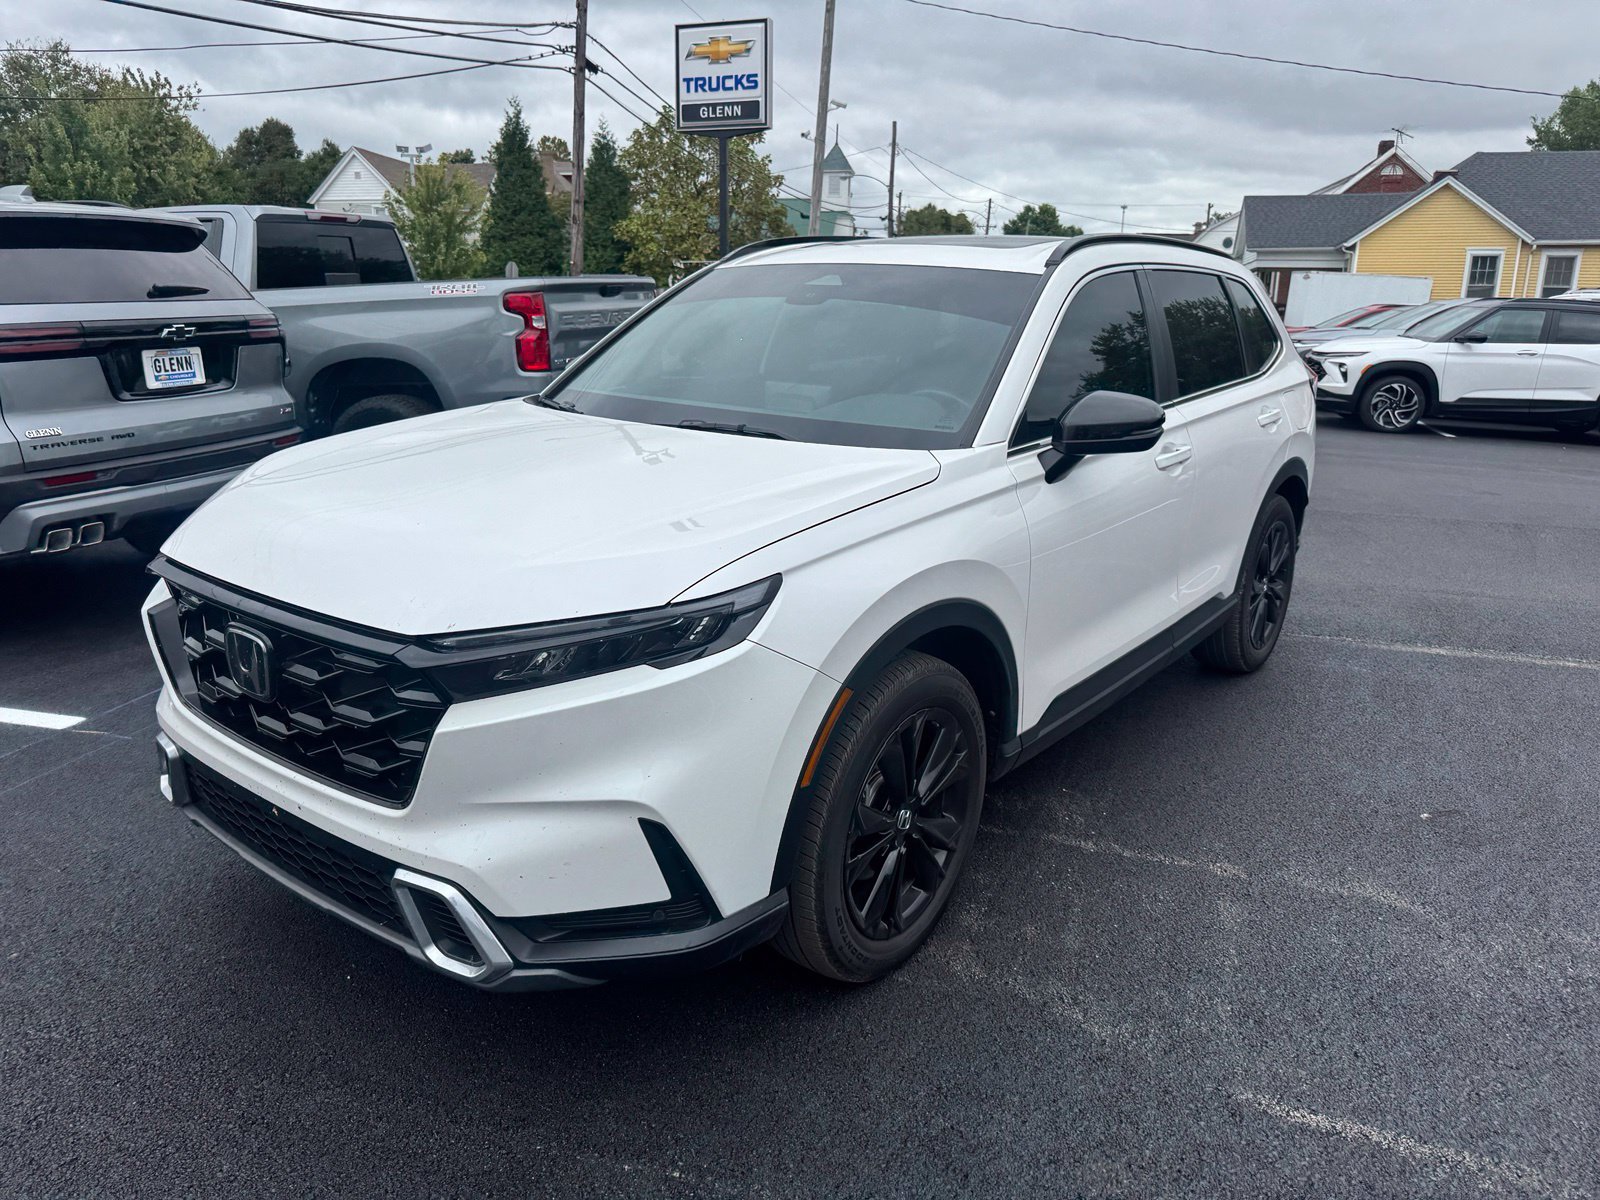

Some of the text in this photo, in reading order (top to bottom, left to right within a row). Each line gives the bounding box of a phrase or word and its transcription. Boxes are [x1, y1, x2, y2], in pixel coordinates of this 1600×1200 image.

[682, 73, 759, 94] TRUCKS
[700, 105, 742, 118] GLENN
[153, 355, 193, 373] GLENN
[25, 426, 63, 439] GLENN
[30, 432, 135, 450] TRAVERSE AWD
